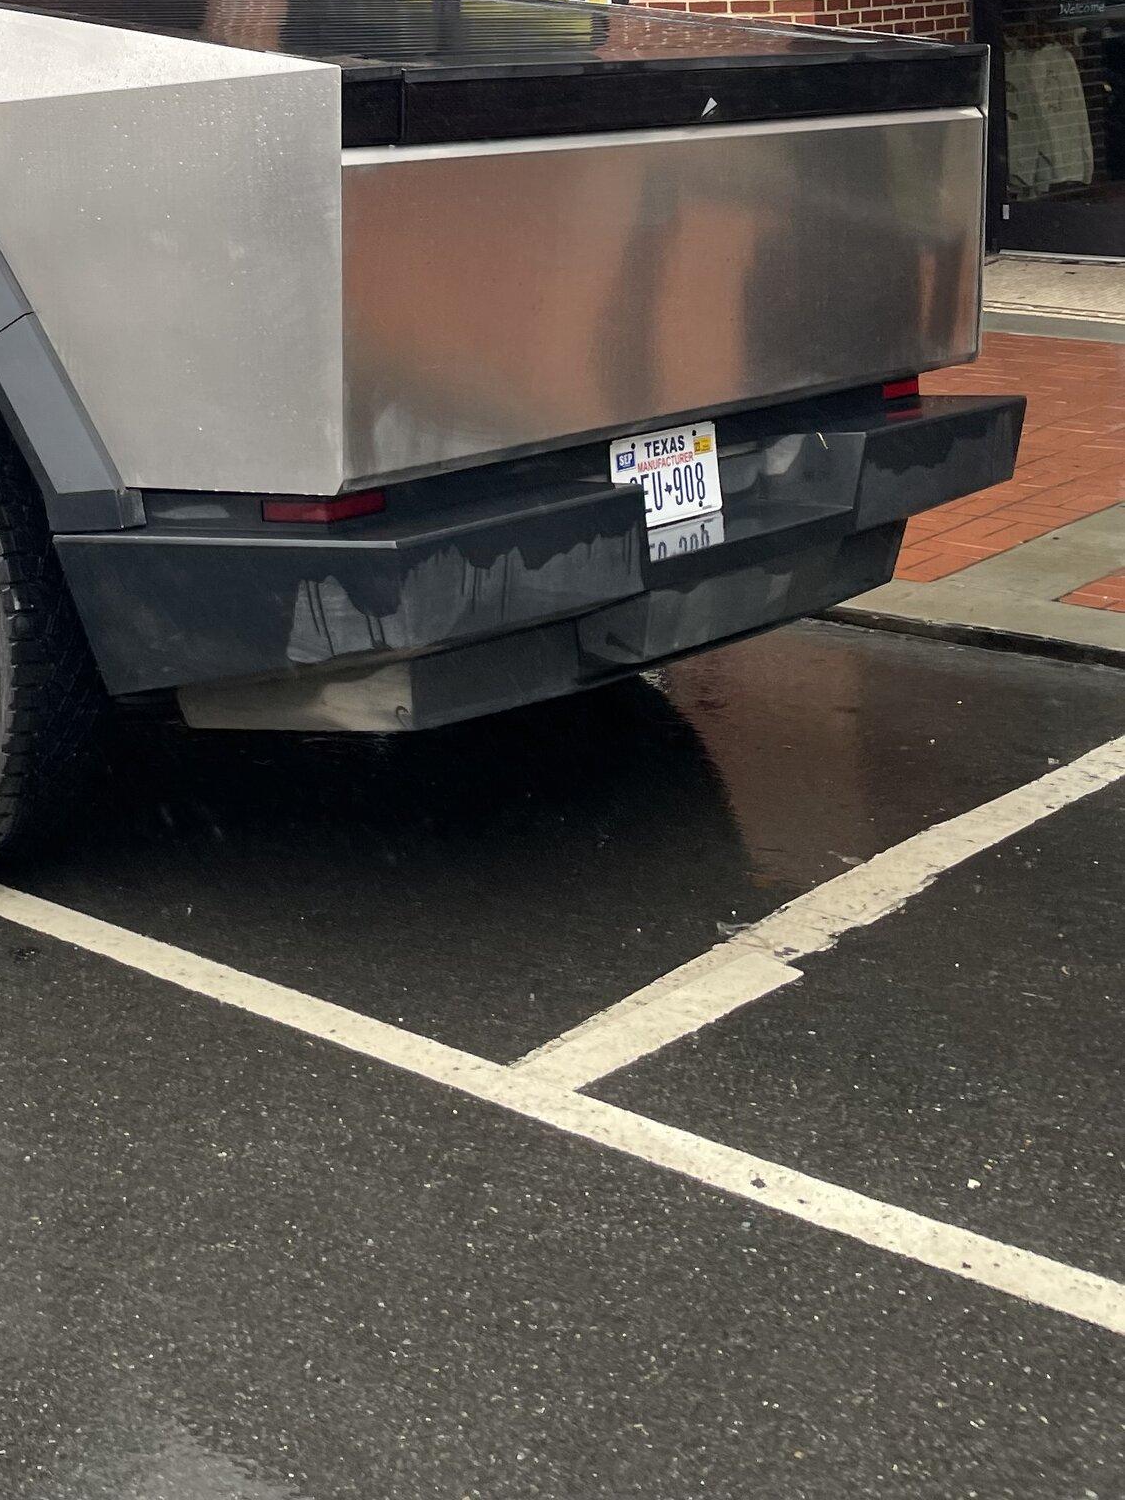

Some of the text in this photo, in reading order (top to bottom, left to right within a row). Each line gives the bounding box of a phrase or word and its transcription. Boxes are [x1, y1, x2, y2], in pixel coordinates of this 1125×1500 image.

[644, 435, 685, 459] TEXAS
[618, 453, 633, 467] SEP
[637, 451, 695, 473] MANUFACTURER
